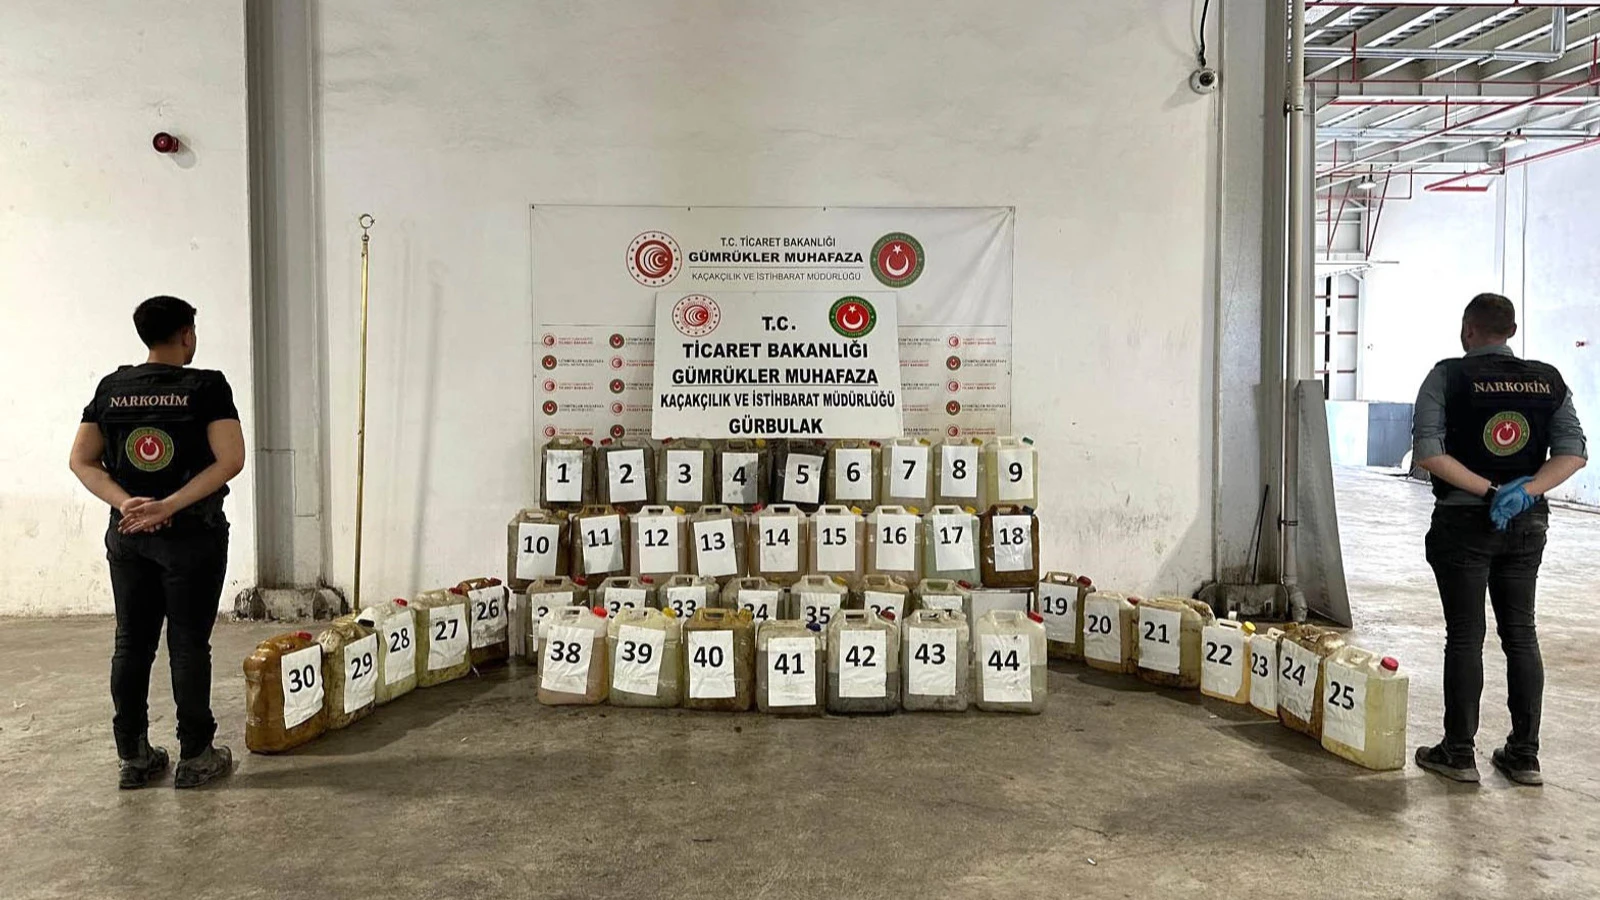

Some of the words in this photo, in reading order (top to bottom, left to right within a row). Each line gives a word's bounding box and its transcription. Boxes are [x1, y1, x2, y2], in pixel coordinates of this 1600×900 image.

[720, 236, 738, 247] T.C.
[739, 235, 781, 248] TİCARET
[783, 235, 836, 247] BAKANLIĞI
[688, 249, 780, 263] GÜMRÜKLER
[784, 252, 864, 263] MUHAFAZA
[691, 272, 742, 283] KAÇAKÇILIK
[742, 272, 755, 281] VE
[756, 271, 805, 281] İSTİHBARAT
[806, 271, 861, 281] MÜDÜRLÜĞÜ
[683, 340, 761, 358] TİCARET
[768, 340, 867, 358] BAKANLIĞI
[673, 366, 780, 384] GÜMRÜKLER
[786, 369, 878, 383] MUHAFAZA
[1473, 381, 1550, 394] NARKOKİM
[110, 393, 189, 407] NARKOKİM
[661, 393, 730, 411] KAÇAKÇILIK
[734, 393, 749, 406] VE
[753, 390, 819, 406] İSTİHBARAT
[823, 391, 894, 407] MÜDÜRLÜĞÜ
[729, 415, 823, 434] GÜRBULAK
[557, 462, 570, 484] 1
[619, 463, 634, 484] 2
[678, 463, 692, 484] 3
[732, 466, 748, 486] 4
[795, 464, 809, 485] 5
[846, 461, 861, 483] 6
[902, 459, 916, 480] 7
[952, 459, 967, 480] 8
[1008, 462, 1023, 483] 9
[523, 535, 550, 555] 10
[587, 528, 613, 548] 11
[644, 528, 670, 547] 12
[700, 532, 726, 552] 13
[765, 528, 791, 547] 14
[822, 527, 847, 546] 15
[882, 526, 907, 545] 16
[939, 525, 964, 545] 17
[999, 526, 1024, 546] 18
[476, 598, 499, 622] 26
[672, 599, 697, 619] 33
[805, 605, 831, 625] 35
[1043, 595, 1068, 616] 19
[434, 618, 459, 641] 27
[1088, 614, 1112, 635] 20
[1144, 620, 1170, 644] 21
[389, 627, 410, 654] 28
[549, 640, 582, 664] 38
[620, 640, 653, 665] 39
[693, 645, 724, 668] 40
[845, 645, 877, 667] 42
[914, 643, 946, 665] 43
[987, 649, 1020, 672] 44
[1206, 641, 1233, 666] 22
[350, 652, 373, 681] 29
[774, 652, 805, 675] 41
[1250, 652, 1269, 678] 23
[1281, 656, 1306, 687] 24
[288, 664, 315, 694] 30
[1328, 680, 1355, 710] 25
